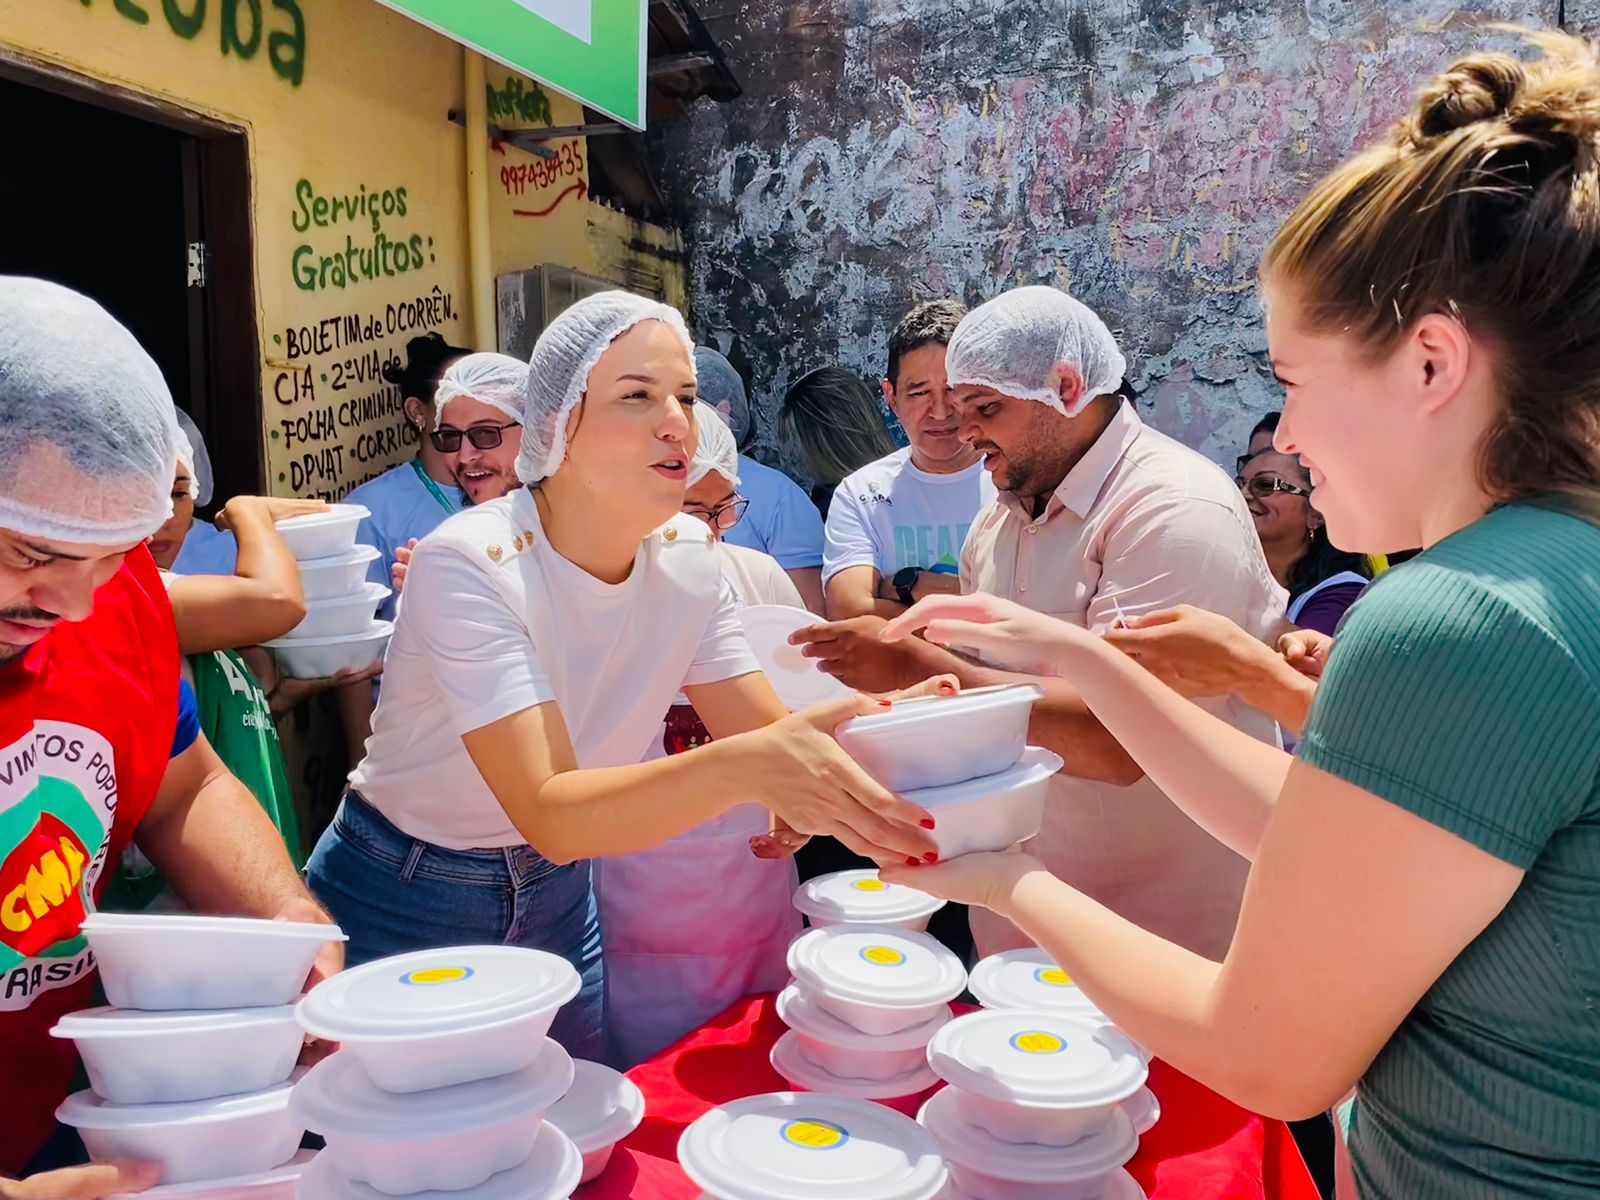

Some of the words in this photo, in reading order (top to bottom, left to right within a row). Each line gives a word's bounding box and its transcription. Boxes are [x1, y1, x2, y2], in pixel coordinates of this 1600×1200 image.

[500, 139, 584, 196] 997438435
[292, 178, 407, 233] Serviços
[286, 313, 364, 359] BOLETIM
[364, 314, 384, 341] de
[274, 364, 315, 405] CIA
[353, 349, 383, 384] VIA
[281, 406, 338, 449] FOLHA
[339, 386, 403, 427] CRIMINAL
[290, 445, 344, 492] DPVAT
[0, 950, 96, 998] RASIL
